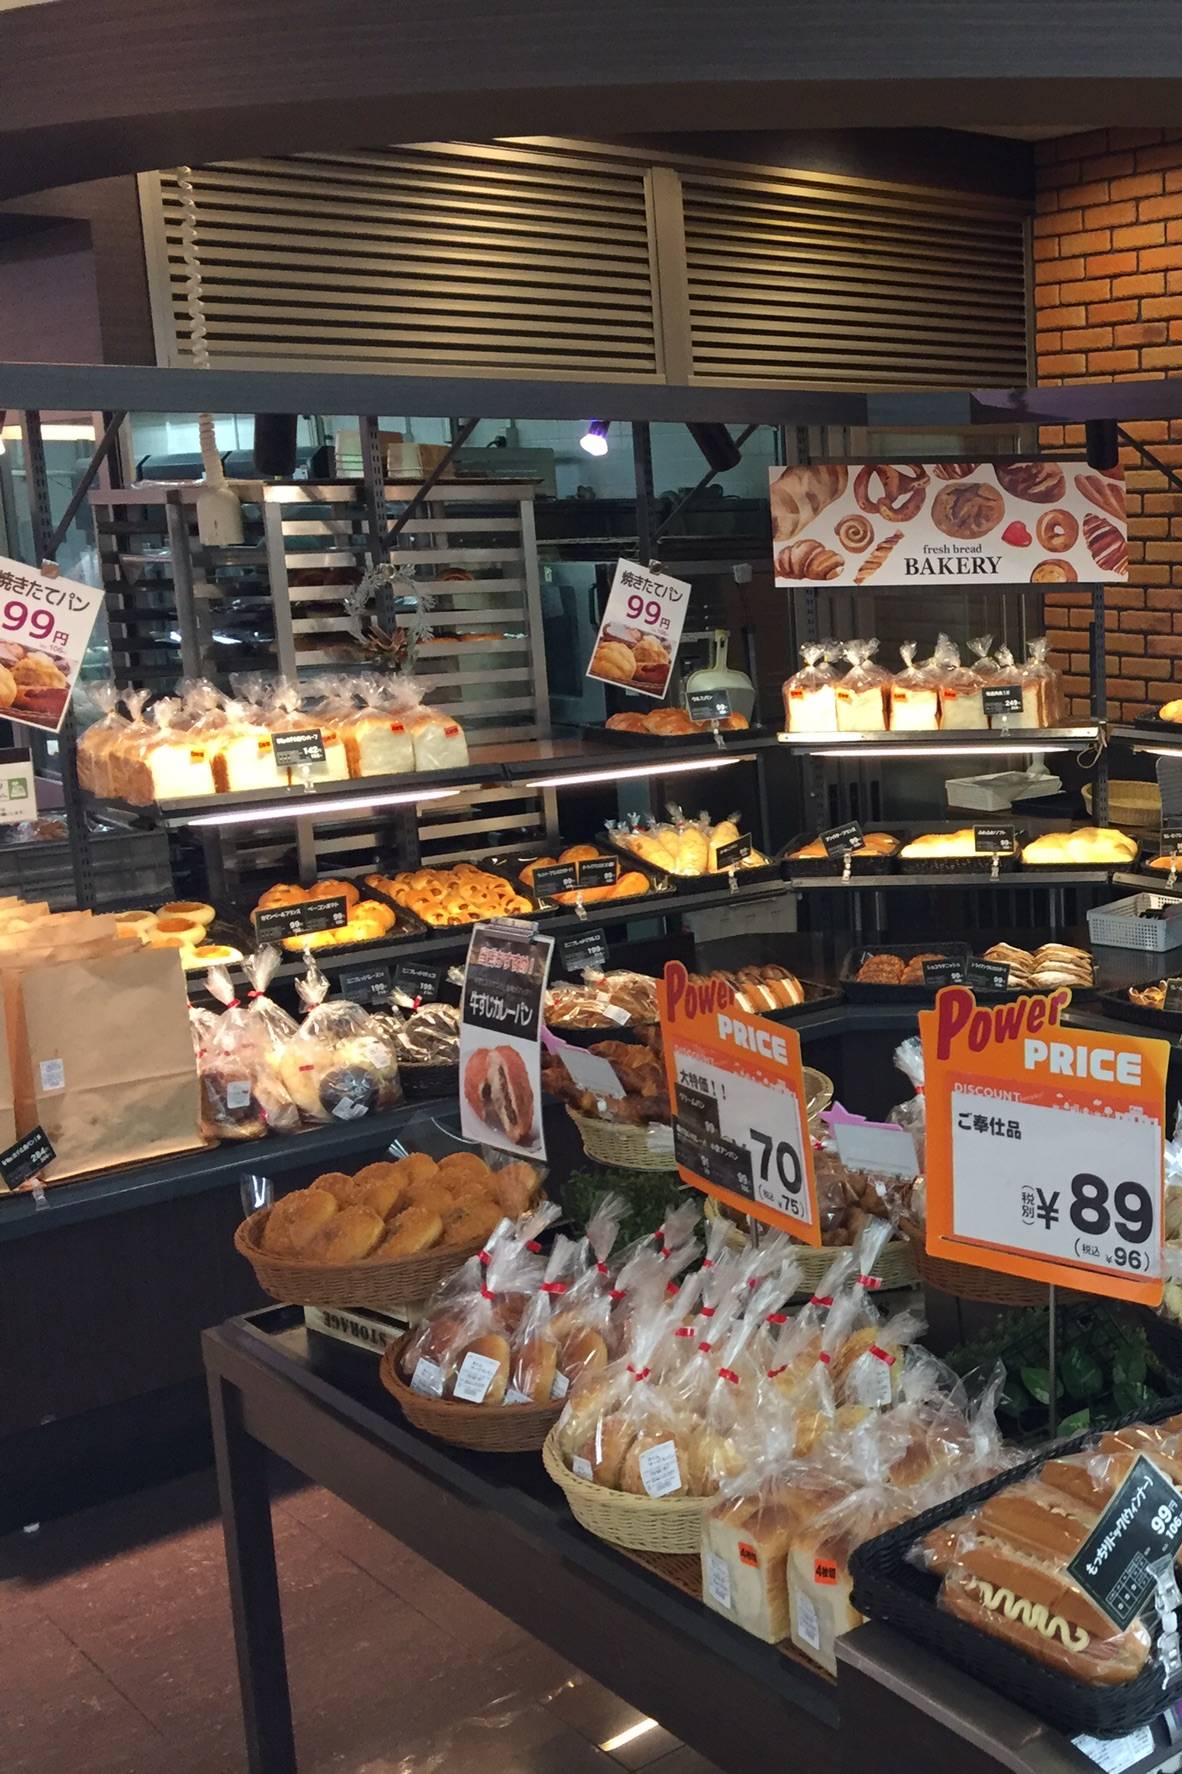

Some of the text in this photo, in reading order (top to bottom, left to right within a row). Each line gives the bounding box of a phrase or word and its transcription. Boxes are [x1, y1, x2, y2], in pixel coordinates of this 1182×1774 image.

[904, 555, 1003, 577] BAKERY
[923, 543, 983, 555] fresh bread
[0, 569, 91, 612] 焼きたてパン
[620, 569, 684, 603] 焼きたてパン
[1, 599, 69, 647] 99円
[625, 594, 671, 631] 99円
[717, 1012, 789, 1066] PRICE
[936, 988, 1068, 1061] Power
[1023, 1038, 1143, 1086] PRICE
[954, 1082, 1021, 1103] DISCOUNT
[957, 1111, 1022, 1140] ご奉仕品
[749, 1127, 803, 1195] 70
[322, 1310, 387, 1347] STORAGE
